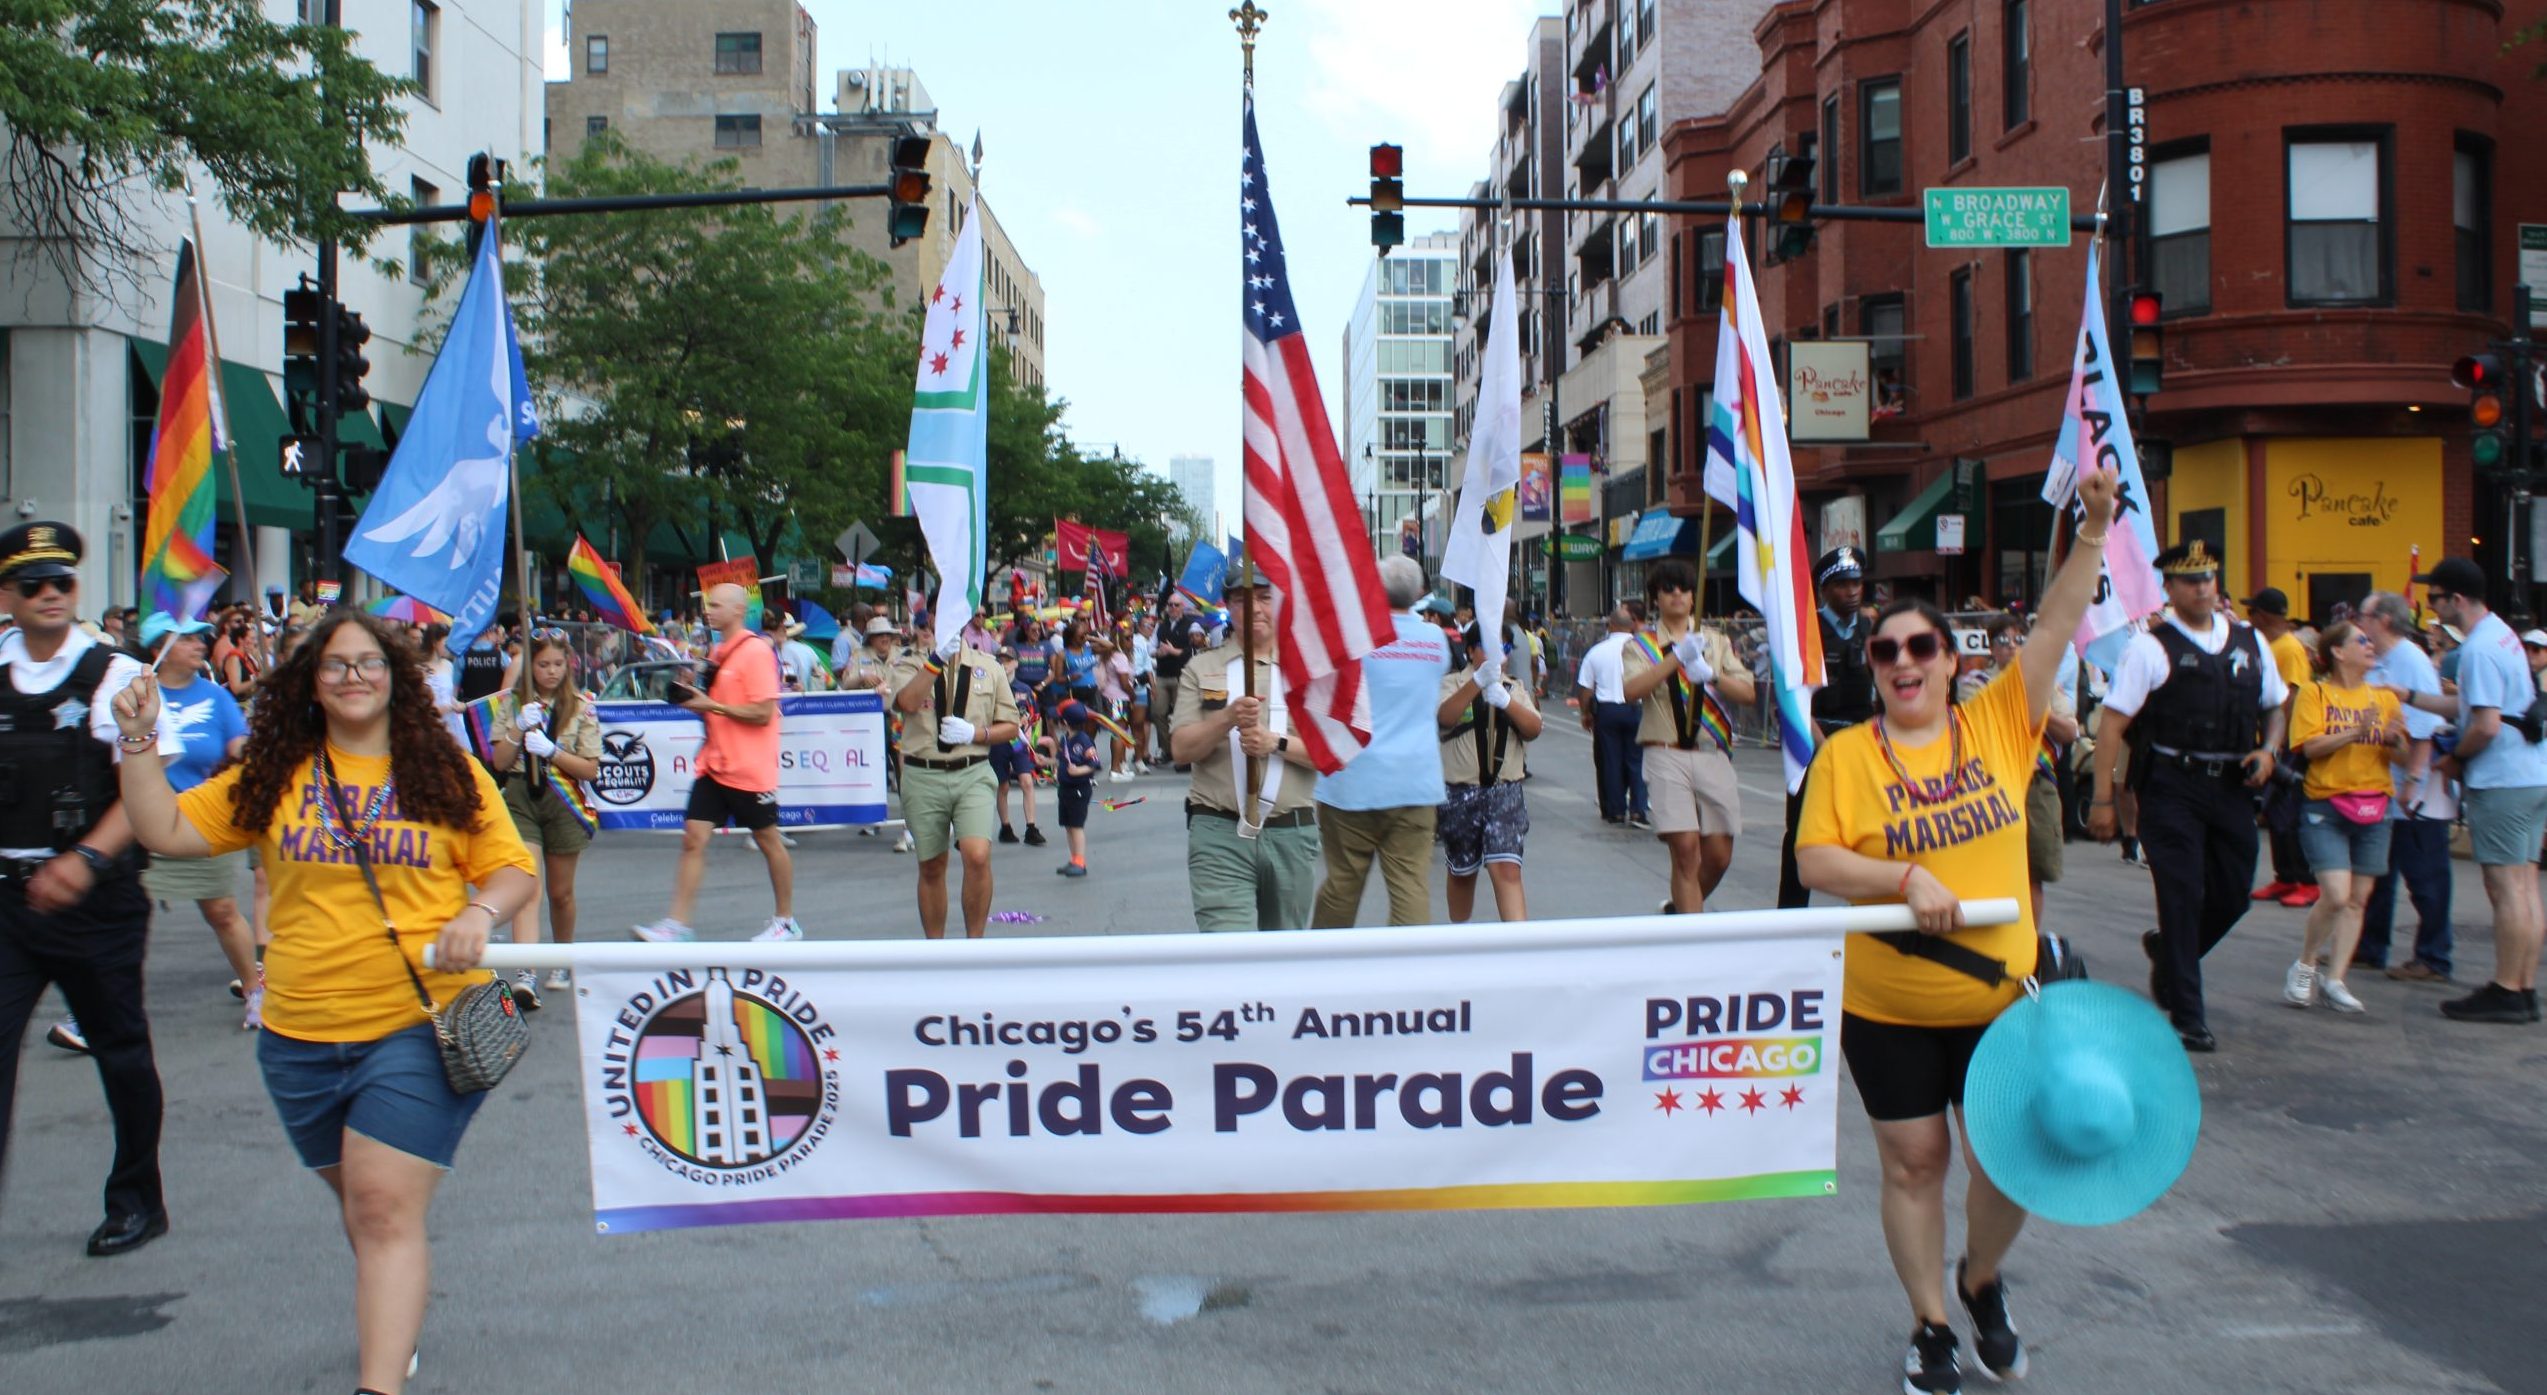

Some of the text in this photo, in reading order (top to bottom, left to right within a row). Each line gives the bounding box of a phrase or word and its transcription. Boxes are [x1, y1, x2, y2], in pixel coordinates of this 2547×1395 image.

[2128, 88, 2144, 202] BR3801
[1933, 194, 2061, 212] N BROADWAY
[1941, 211, 2056, 229] W GRACE ST
[1950, 228, 1975, 240] 800
[2006, 228, 2039, 240] 3800
[1794, 366, 1867, 395] Pancake
[2287, 472, 2399, 522] Pancake
[2348, 515, 2380, 527] cafe
[467, 656, 498, 669] POLICE
[597, 765, 649, 778] SCOUTS
[605, 777, 647, 788] EQUALITY
[1883, 787, 2020, 858] MARSHAL
[915, 1000, 1471, 1055] Chicago's 54th Annual
[1645, 989, 1825, 1039] PRIDE
[603, 967, 836, 1119] UNITED IN PRIDE
[1648, 1043, 1817, 1076] CHICAGO
[885, 1050, 1604, 1138] Pride Parade
[639, 1069, 840, 1187] CHICAGO PRIDE PARADE 2025
